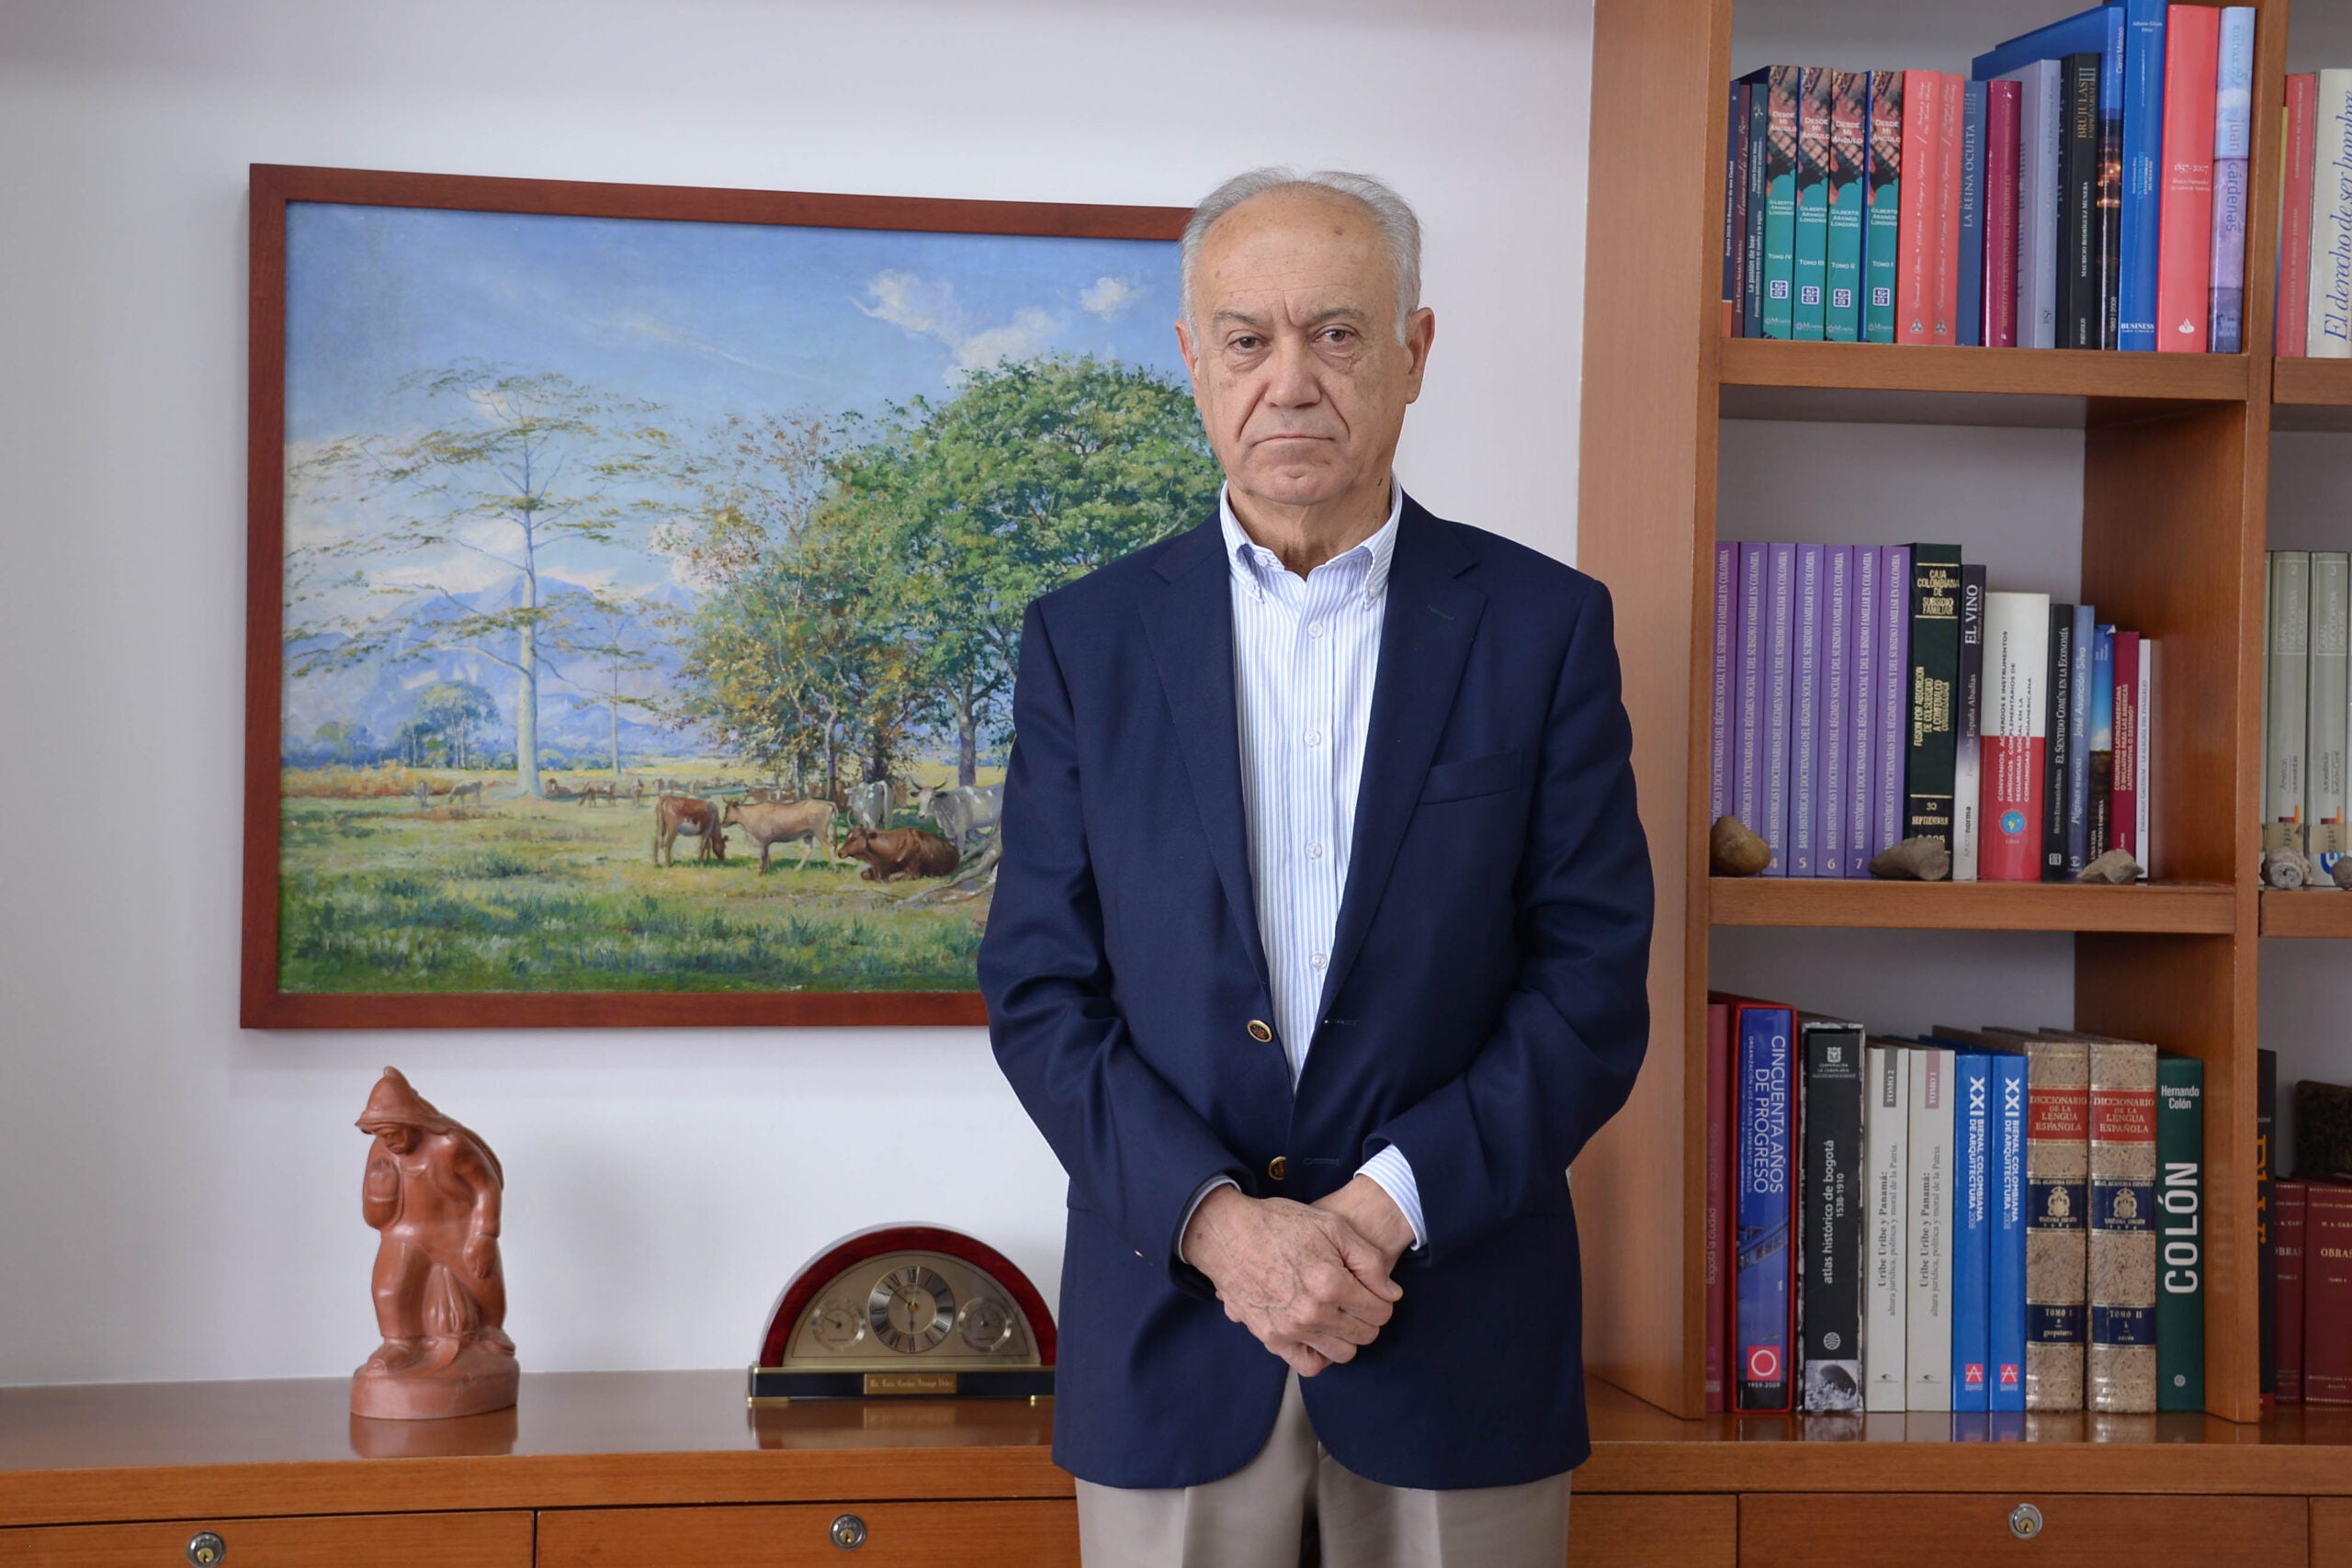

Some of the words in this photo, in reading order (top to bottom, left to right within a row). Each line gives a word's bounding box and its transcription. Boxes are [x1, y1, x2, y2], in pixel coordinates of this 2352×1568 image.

[2075, 81, 2088, 138] BRÚJULAS
[1965, 124, 1975, 171] OCULTA
[2227, 119, 2244, 152] juan
[1964, 175, 1974, 211] REINA
[2226, 162, 2243, 232] cárdenas
[1963, 214, 1973, 228] LA
[2329, 206, 2351, 231] de
[1748, 235, 1757, 249] leer
[1748, 250, 1756, 259] de
[2326, 234, 2350, 311] derecho
[2324, 312, 2348, 342] El
[1917, 577, 1960, 589] COLOMBIANA
[1929, 570, 1947, 580] CAJA
[1922, 596, 1954, 607] SUBSIDIO
[1933, 587, 1943, 597] DE
[1965, 584, 1978, 624] VINO
[1922, 604, 1953, 615] FAMILIAR
[1964, 625, 1977, 644] EL
[2057, 626, 2069, 667] ECONOMÍA
[2000, 631, 2008, 694] INSTRUMENTOS
[2010, 662, 2016, 673] DE
[2075, 647, 2086, 670] Silva
[1915, 666, 1925, 705] ABSORCION
[2056, 679, 2067, 689] EN
[2057, 668, 2067, 678] LA
[1924, 677, 1934, 722] COLSUBSIDIO
[1933, 680, 1943, 725] COMFENALCO
[2018, 698, 2023, 707] LA
[2056, 690, 2067, 718] COMÚN
[2074, 672, 2086, 715] Asunción
[1914, 706, 1924, 721] POR
[1966, 708, 1976, 737] España
[2007, 675, 2016, 755] COMPLEMENTARIOS
[2018, 709, 2023, 721] EN
[2074, 717, 2085, 737] José
[2114, 685, 2122, 749] LATINOAMERICANA
[1914, 722, 1924, 747] FUSION
[1923, 723, 1933, 733] DE
[2055, 719, 2066, 753] SENTIDO
[2054, 754, 2065, 764] EL
[1997, 751, 2006, 802] CONVENIOS,
[2006, 760, 2014, 802] JURÍDICOS
[1926, 801, 1937, 811] 30
[2071, 789, 2083, 825] Páginas
[1911, 816, 1949, 826] SEPTIEMBRE
[1799, 857, 1807, 868] 5
[1827, 858, 1836, 870] 6
[1855, 858, 1863, 869] 7
[1755, 1068, 1770, 1092] DE
[1770, 1035, 1785, 1137] CINCUENTA
[1886, 1076, 1895, 1103] TOMO
[1928, 1077, 1937, 1104] TOMO
[2161, 1085, 2199, 1097] Hernando
[1970, 1076, 1984, 1116] XXI
[2005, 1077, 2019, 1117] XXI
[2030, 1095, 2086, 1105] DICCIONARIO
[2094, 1097, 2154, 1107] DICCIONARIO
[2168, 1097, 2191, 1110] Colón
[1970, 1119, 1977, 1132] DE
[2004, 1120, 2012, 1133] DE
[2035, 1121, 2083, 1132] ESPAÑOLA
[2041, 1111, 2078, 1122] LENGUA
[2099, 1122, 2149, 1134] ESPAÑOLA
[2106, 1113, 2144, 1122] LENGUA
[1754, 1097, 1770, 1194] PROGRESO
[2011, 1119, 2019, 1155] BIENAL
[1770, 1141, 1786, 1194] AÑOS
[1823, 1140, 1835, 1183] bogotá
[1969, 1133, 1977, 1209] ARQUITECTURA
[2003, 1134, 2012, 1210] ARQUITECTURA
[1823, 1186, 1835, 1201] de
[1836, 1173, 1844, 1218] 1538-1910
[1879, 1171, 1888, 1216] Panamá:
[1920, 1172, 1930, 1216] Panamá:
[1976, 1156, 1984, 1221] COLOMBIANA
[2011, 1156, 2019, 1222] COLOMBIANA
[1707, 1208, 1717, 1240] ciudad
[1823, 1203, 1834, 1254] histórico
[2003, 1212, 2011, 1229] 2008
[2157, 1162, 2198, 1293] COLÓN
[1707, 1240, 1717, 1249] la
[1878, 1226, 1888, 1256] Uribe
[1920, 1227, 1930, 1257] Uribe
[1706, 1251, 1717, 1285] Bogotá
[1822, 1257, 1834, 1285] atlas
[1878, 1258, 1887, 1287] Uribe
[1919, 1258, 1929, 1287] Uribe
[2045, 1309, 2065, 1317] TOMO
[2109, 1310, 2132, 1319] TOMO
[2135, 1311, 2143, 1319] II
